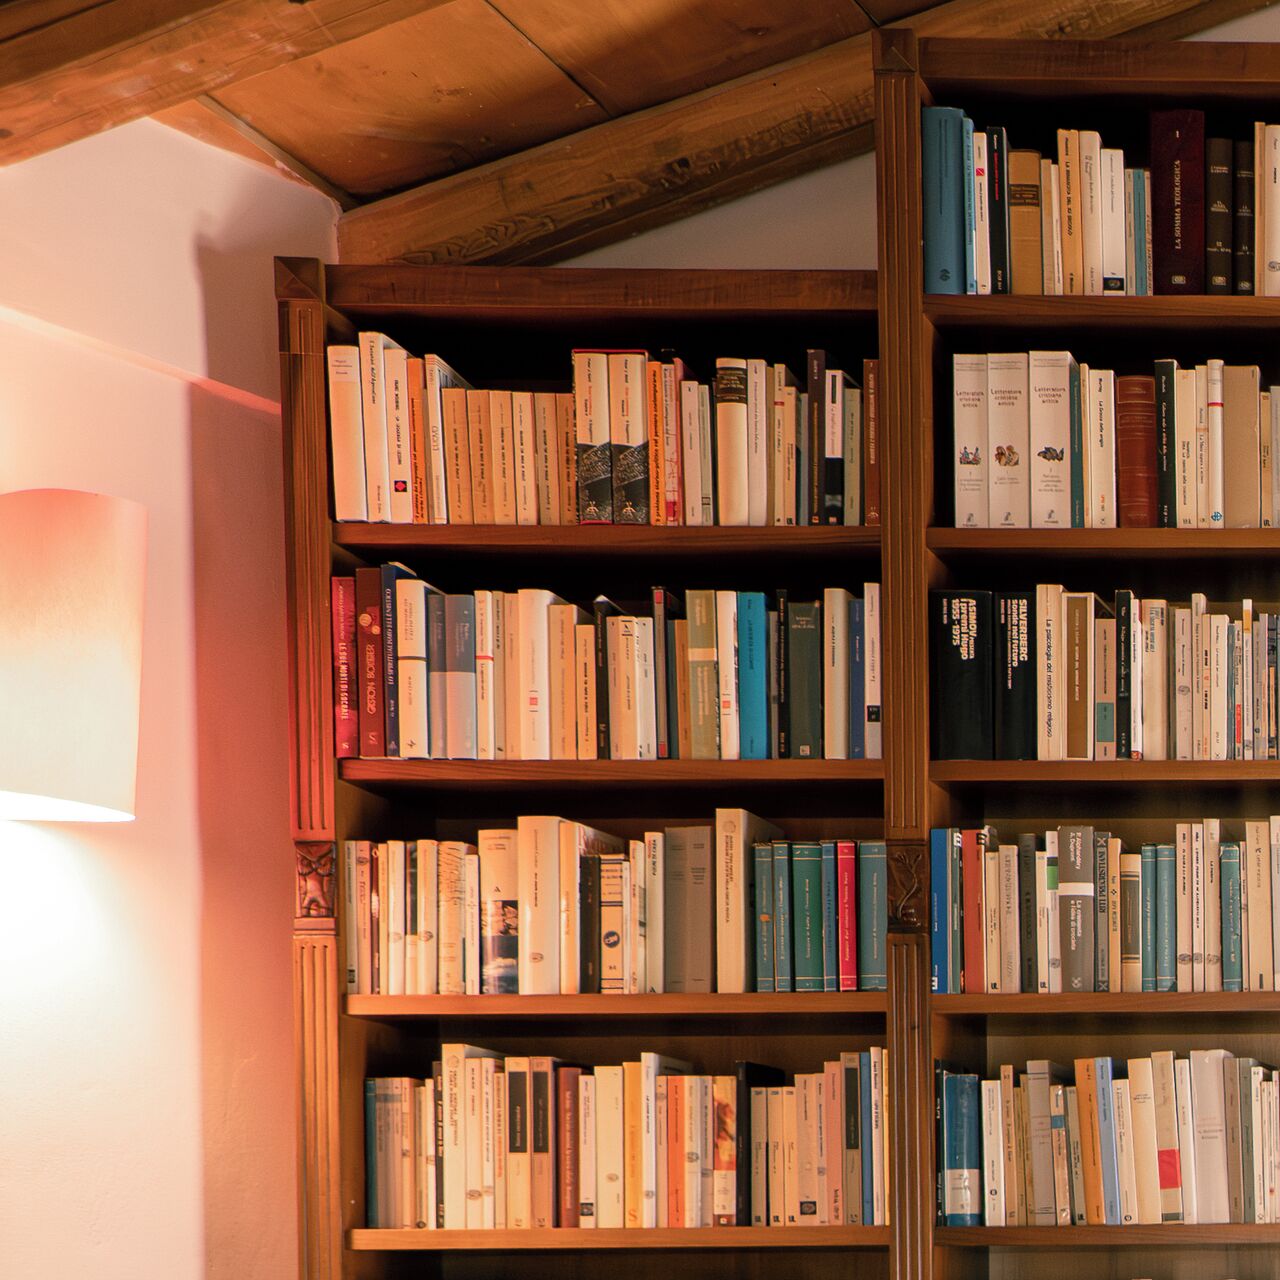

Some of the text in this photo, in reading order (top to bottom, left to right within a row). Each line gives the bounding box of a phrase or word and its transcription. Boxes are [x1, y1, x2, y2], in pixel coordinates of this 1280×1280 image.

[1173, 159, 1183, 250] LA SOMMA TEOLOGICA
[951, 598, 961, 646] 1955-1975
[960, 602, 969, 633] premi
[968, 598, 977, 638] ASIMOV
[1011, 599, 1020, 625] sonde
[1011, 625, 1020, 639] nel
[1018, 599, 1028, 662] SILVERBERG
[339, 642, 349, 651] LE
[339, 652, 349, 665] DUE
[960, 634, 970, 660] Hugo
[339, 666, 349, 686] MORTI
[1044, 619, 1054, 738] La psicologia del misticismo religioso
[339, 693, 349, 720] SOCRATE
[1098, 898, 1107, 914] RITI
